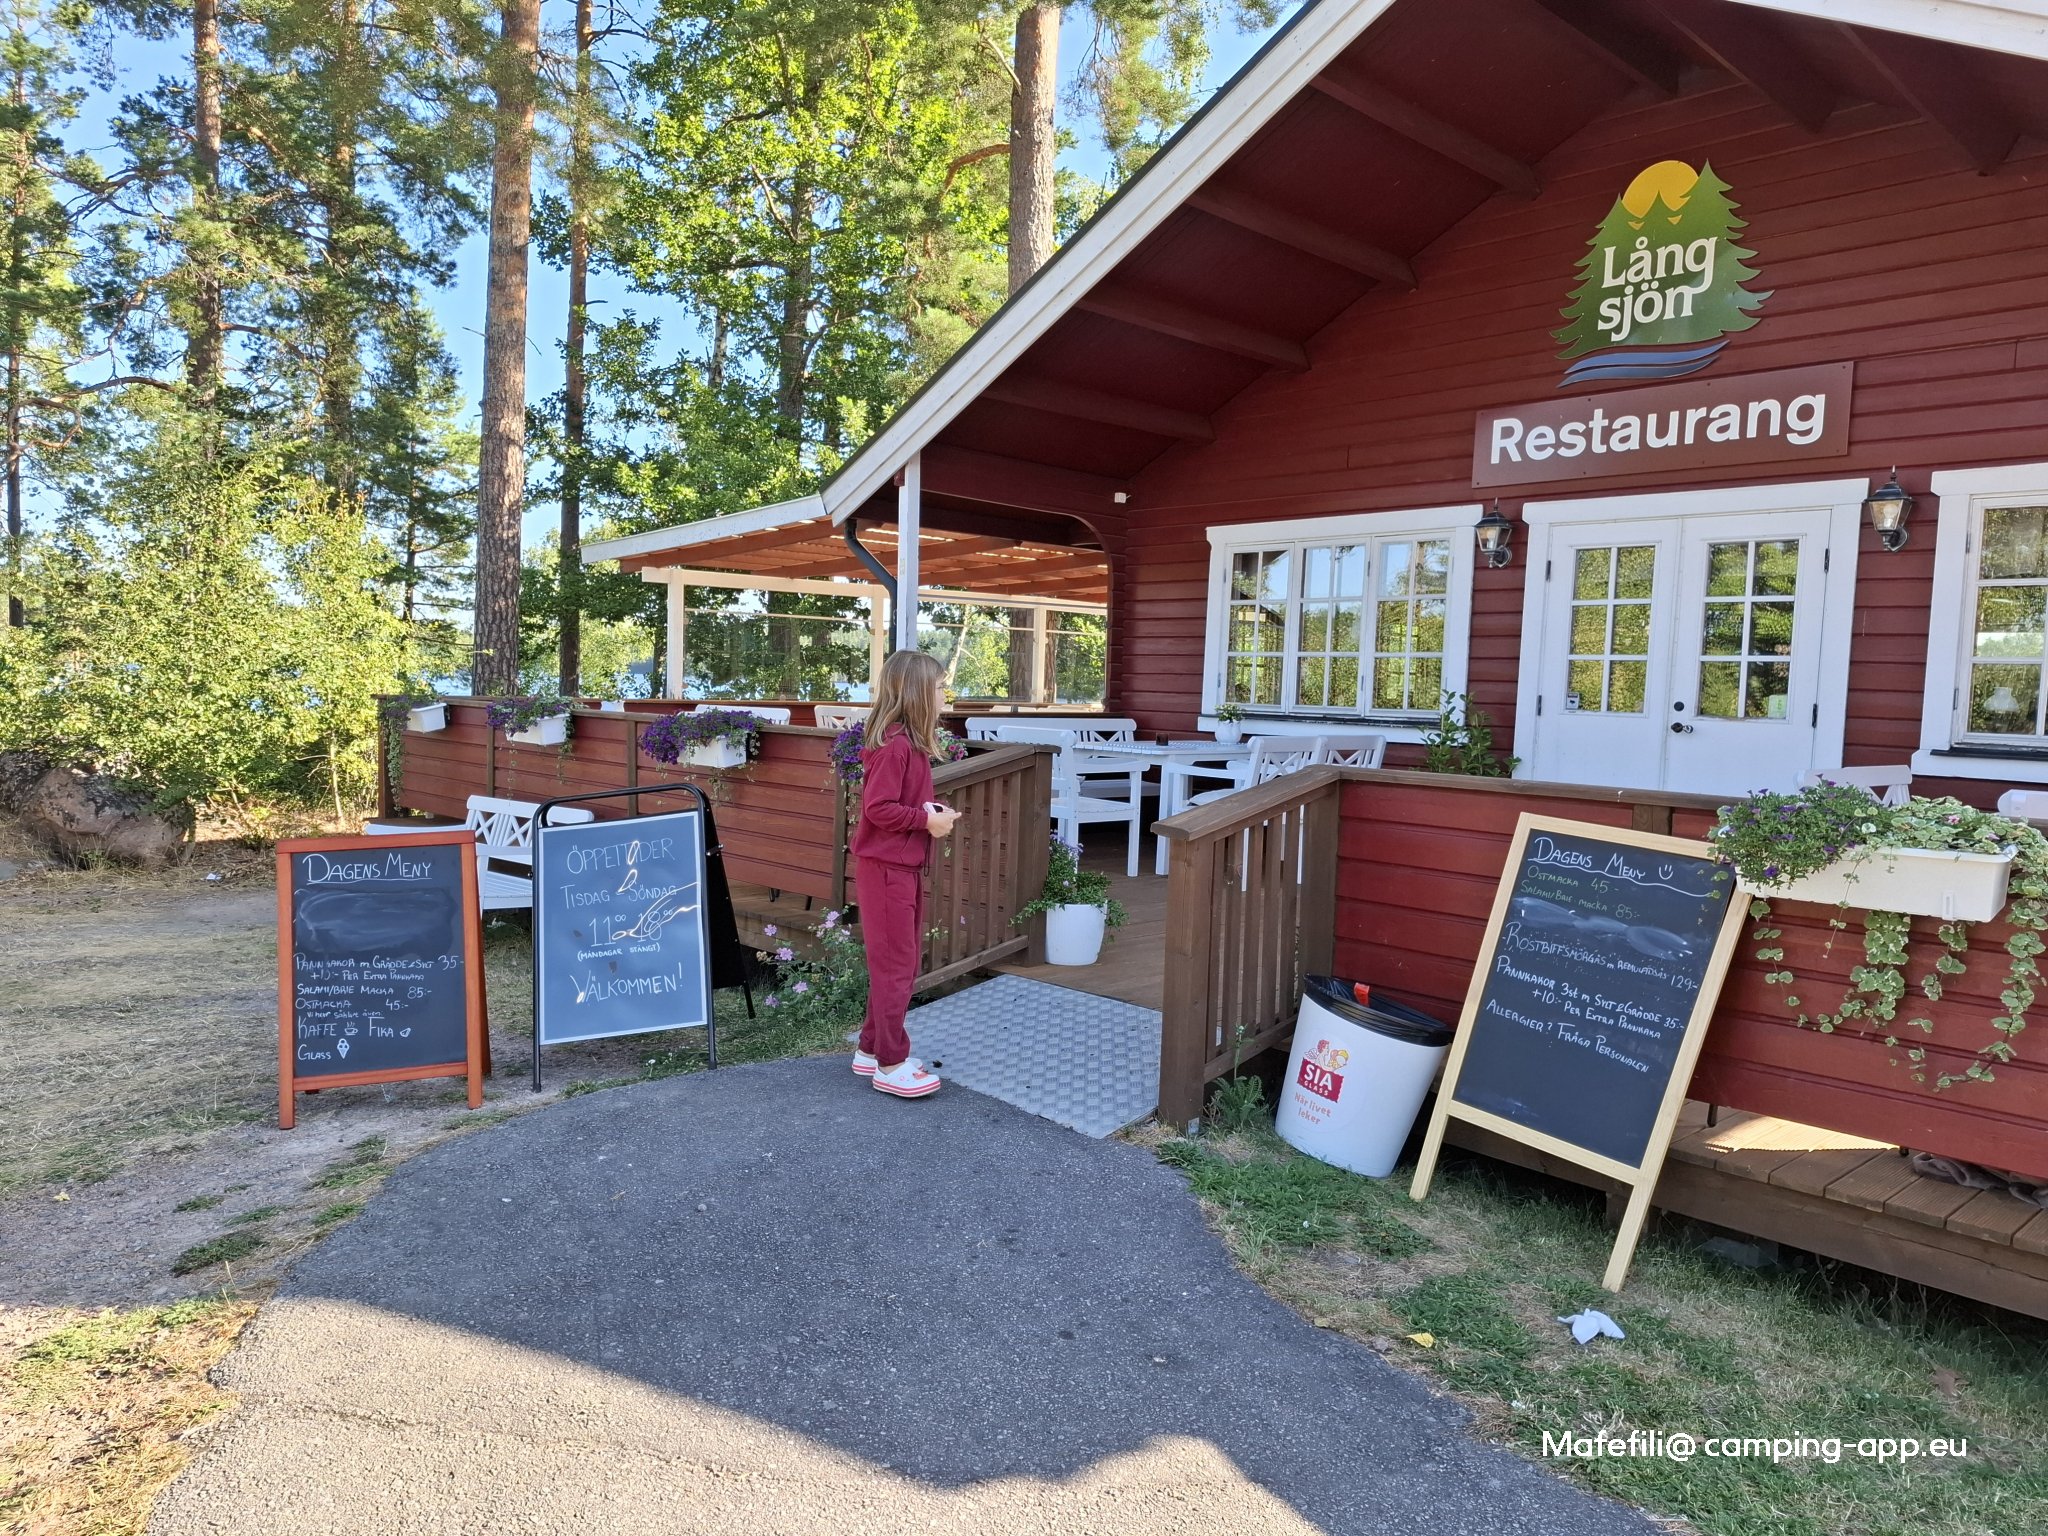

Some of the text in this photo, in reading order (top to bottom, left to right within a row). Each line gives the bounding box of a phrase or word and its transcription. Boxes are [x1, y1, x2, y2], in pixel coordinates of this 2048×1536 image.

[1601, 236, 1718, 294] Lång
[1598, 281, 1702, 341] sjön
[1490, 394, 1826, 465] Restaurang
[302, 852, 431, 883] DAGENS MENY
[567, 838, 675, 874] ÖPPETTIDER
[1534, 837, 1646, 879] DAGENS MENY
[560, 884, 610, 909] TISDAG
[629, 885, 677, 902] SÖNDAG
[342, 970, 359, 980] PER
[569, 962, 684, 1004] VÄLKOMMEN!
[298, 1016, 395, 1039] KAFFE FIKA
[297, 1044, 332, 1060] GLASS
[1304, 1063, 1333, 1091] SIA
[1304, 1080, 1329, 1096] GLASS
[1297, 1107, 1321, 1125] leker
